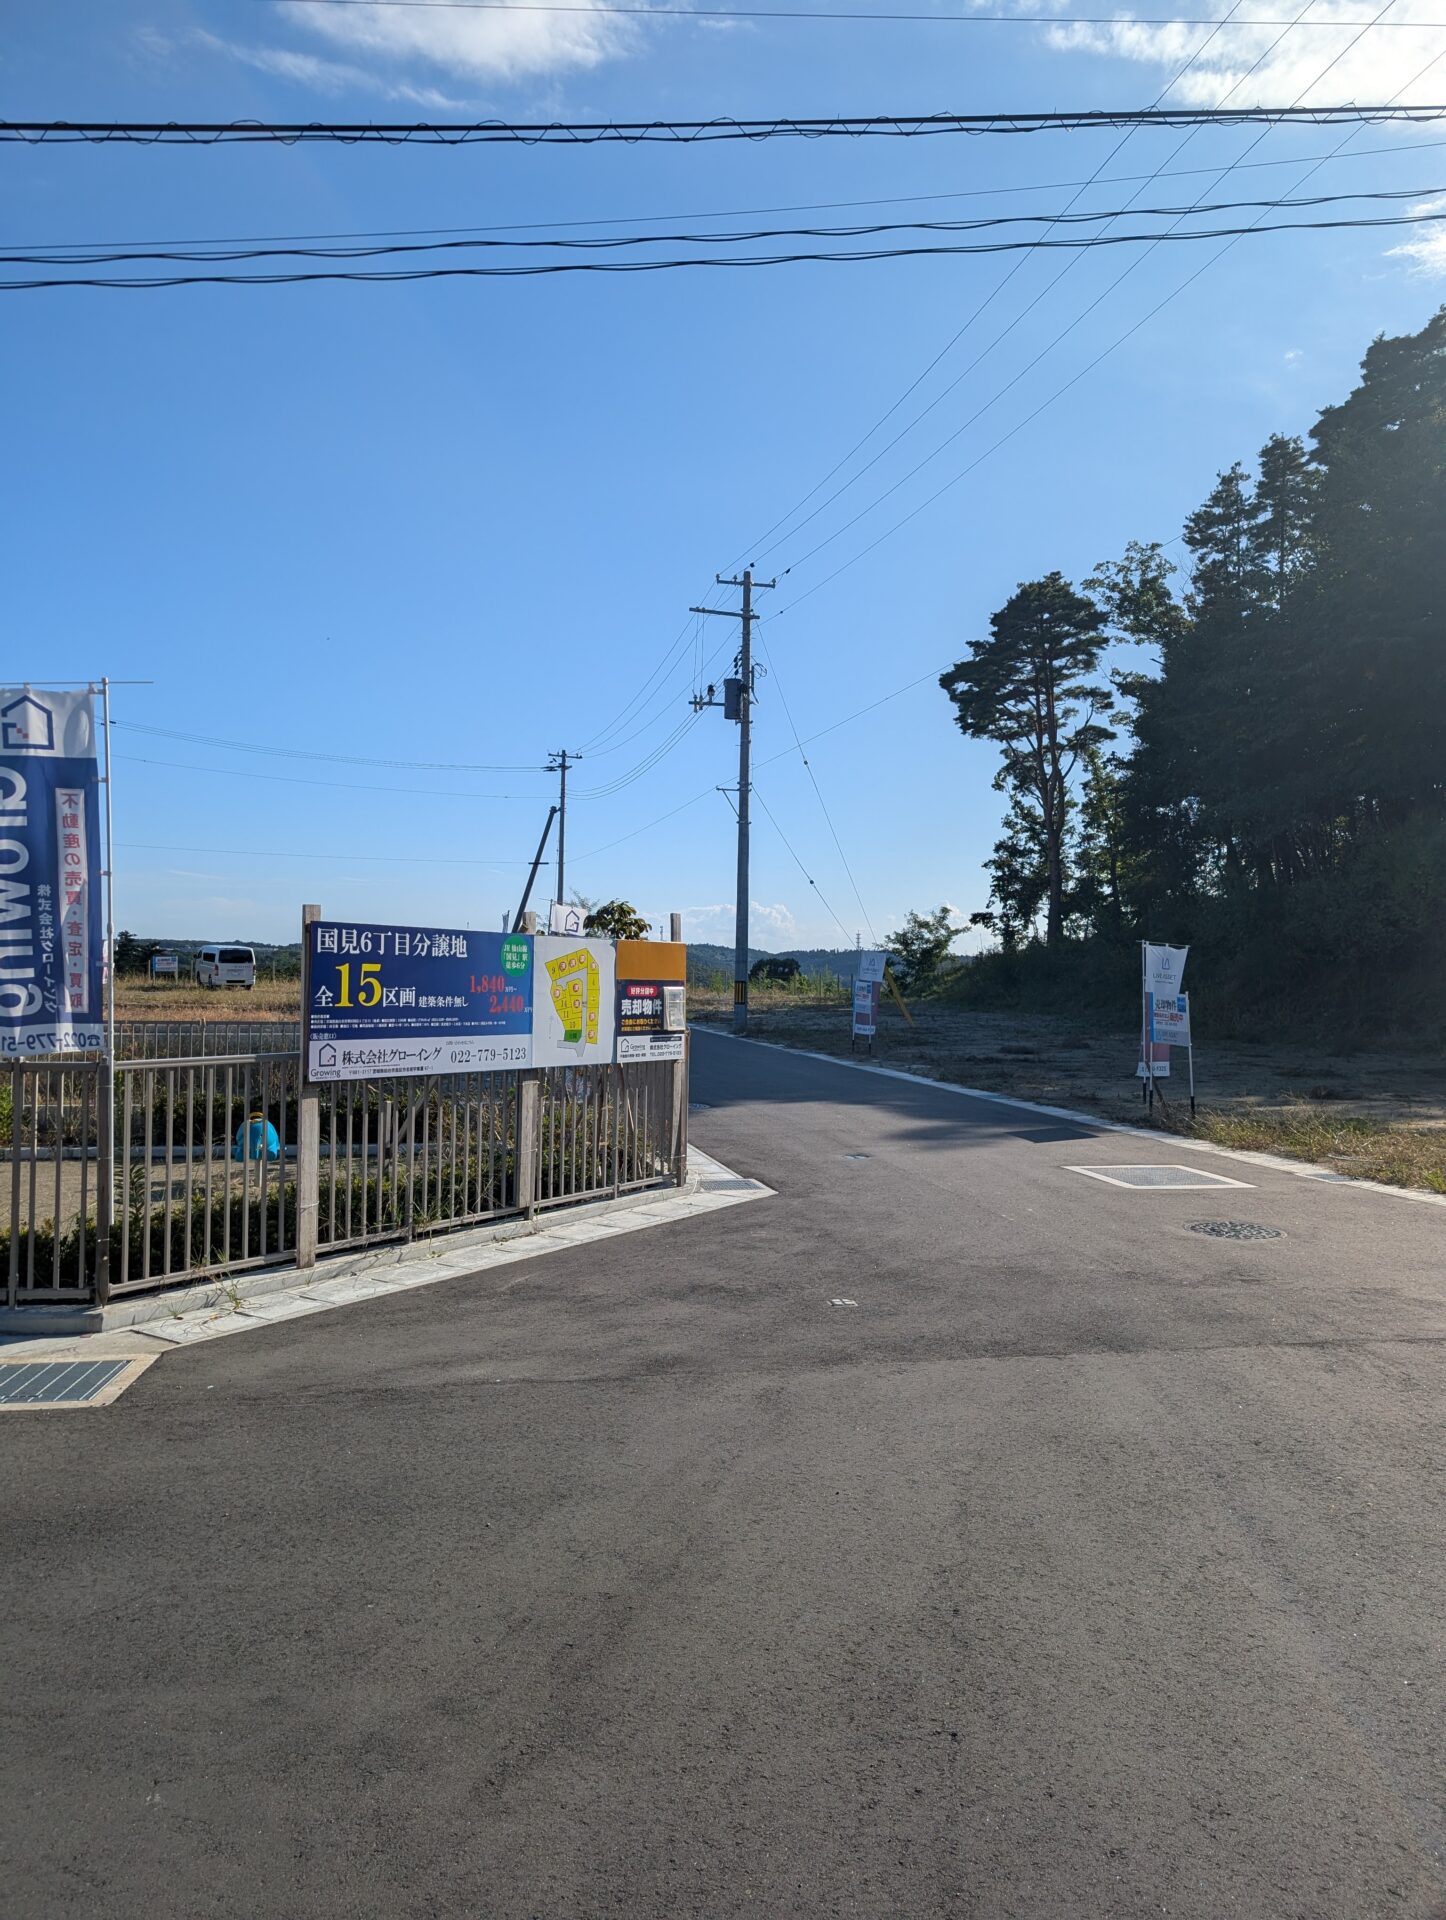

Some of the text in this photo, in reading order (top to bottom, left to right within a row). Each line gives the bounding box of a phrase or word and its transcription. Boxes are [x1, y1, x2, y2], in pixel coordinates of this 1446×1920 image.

[317, 927, 468, 958] 国見6丁目分譲地
[314, 963, 469, 1008] 全15区画 建築条件無し
[621, 999, 662, 1016] 売却物件
[342, 1046, 443, 1066] 株式会社グローイング
[450, 1047, 527, 1063] 022-779-5123
[311, 1068, 341, 1078] Growing
